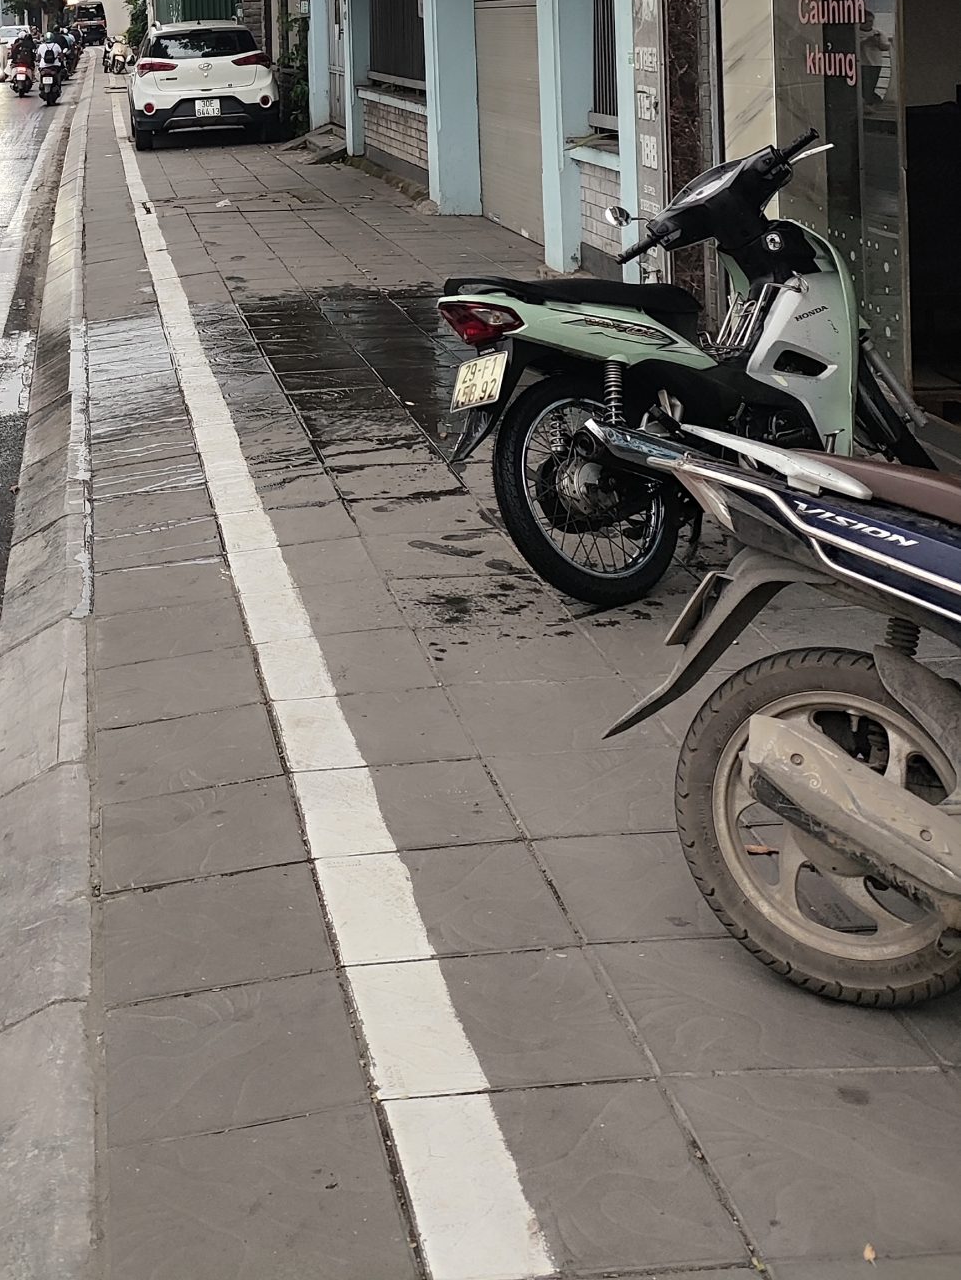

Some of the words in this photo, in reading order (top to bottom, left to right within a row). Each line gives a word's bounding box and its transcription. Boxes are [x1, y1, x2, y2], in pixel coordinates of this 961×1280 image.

[635, 46, 657, 72] CYBER
[806, 42, 857, 87] khủng
[201, 99, 215, 108] 30E
[639, 133, 658, 170] 188
[794, 305, 829, 322] HONDA
[794, 500, 920, 547] VISION
